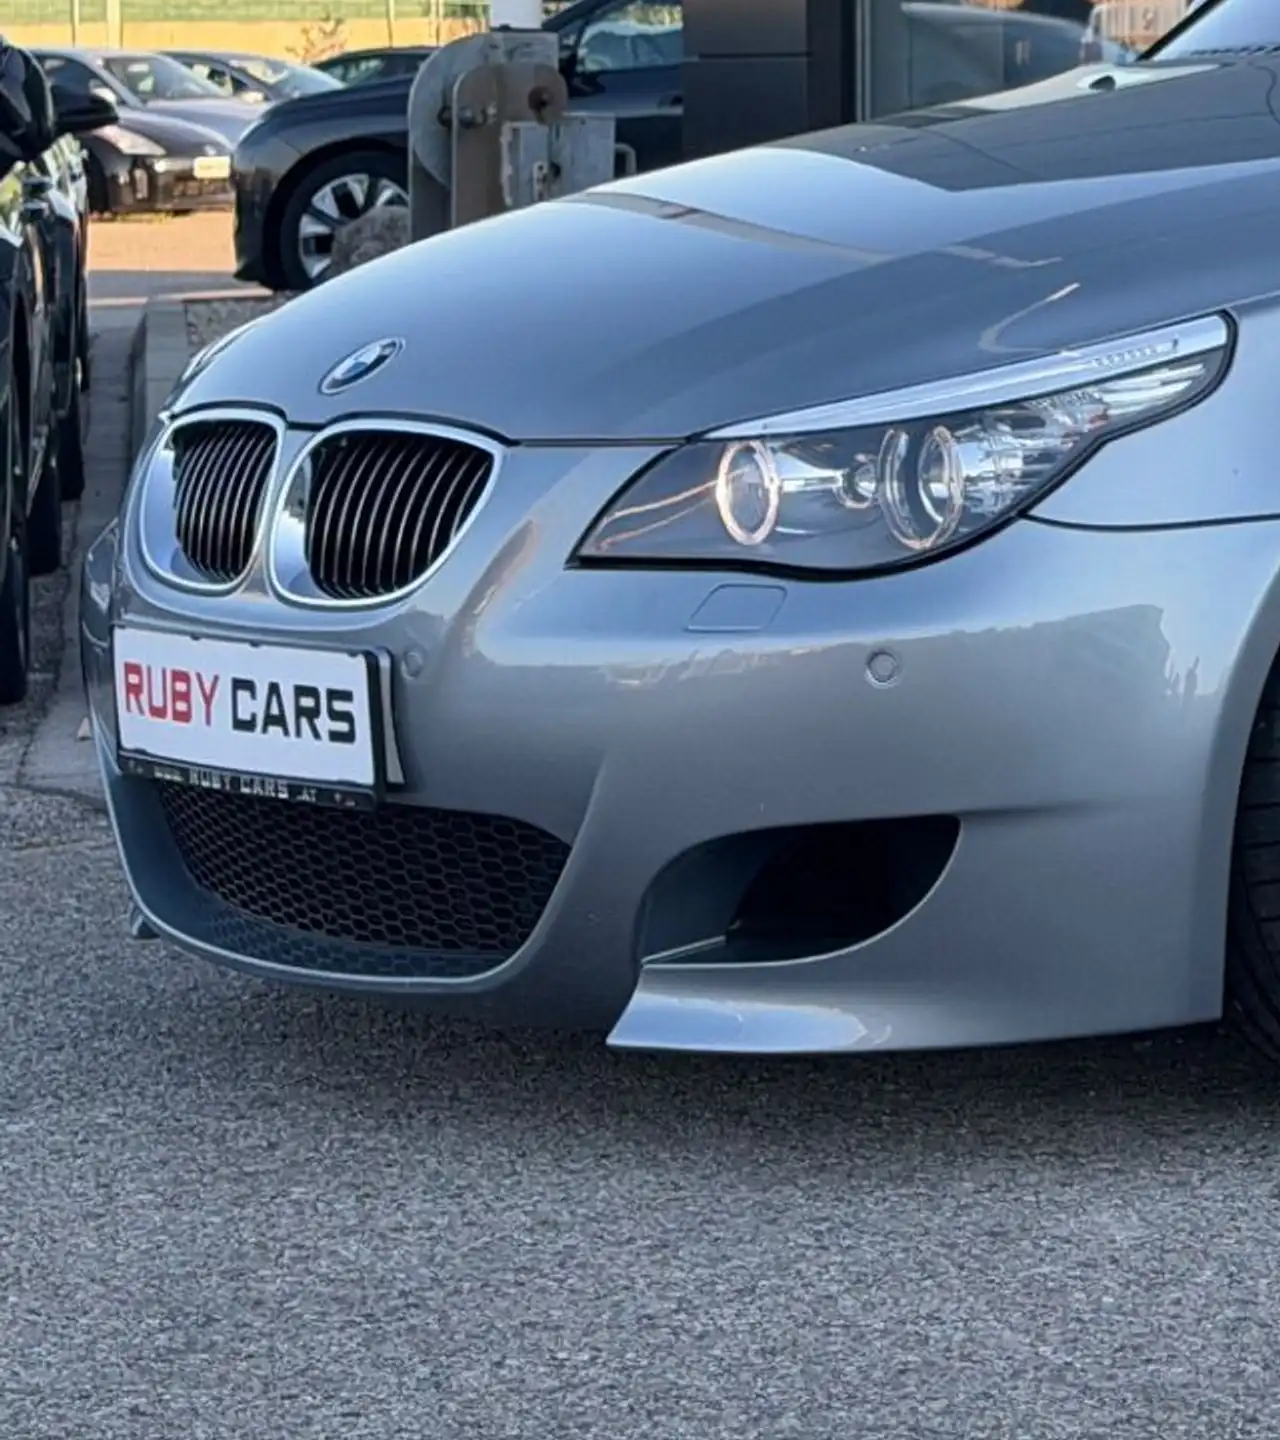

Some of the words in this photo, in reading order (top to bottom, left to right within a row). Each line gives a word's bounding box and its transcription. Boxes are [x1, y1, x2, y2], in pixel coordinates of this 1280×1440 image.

[123, 661, 220, 726] RUBY
[231, 677, 356, 743] CARS
[239, 774, 289, 799] CARS
